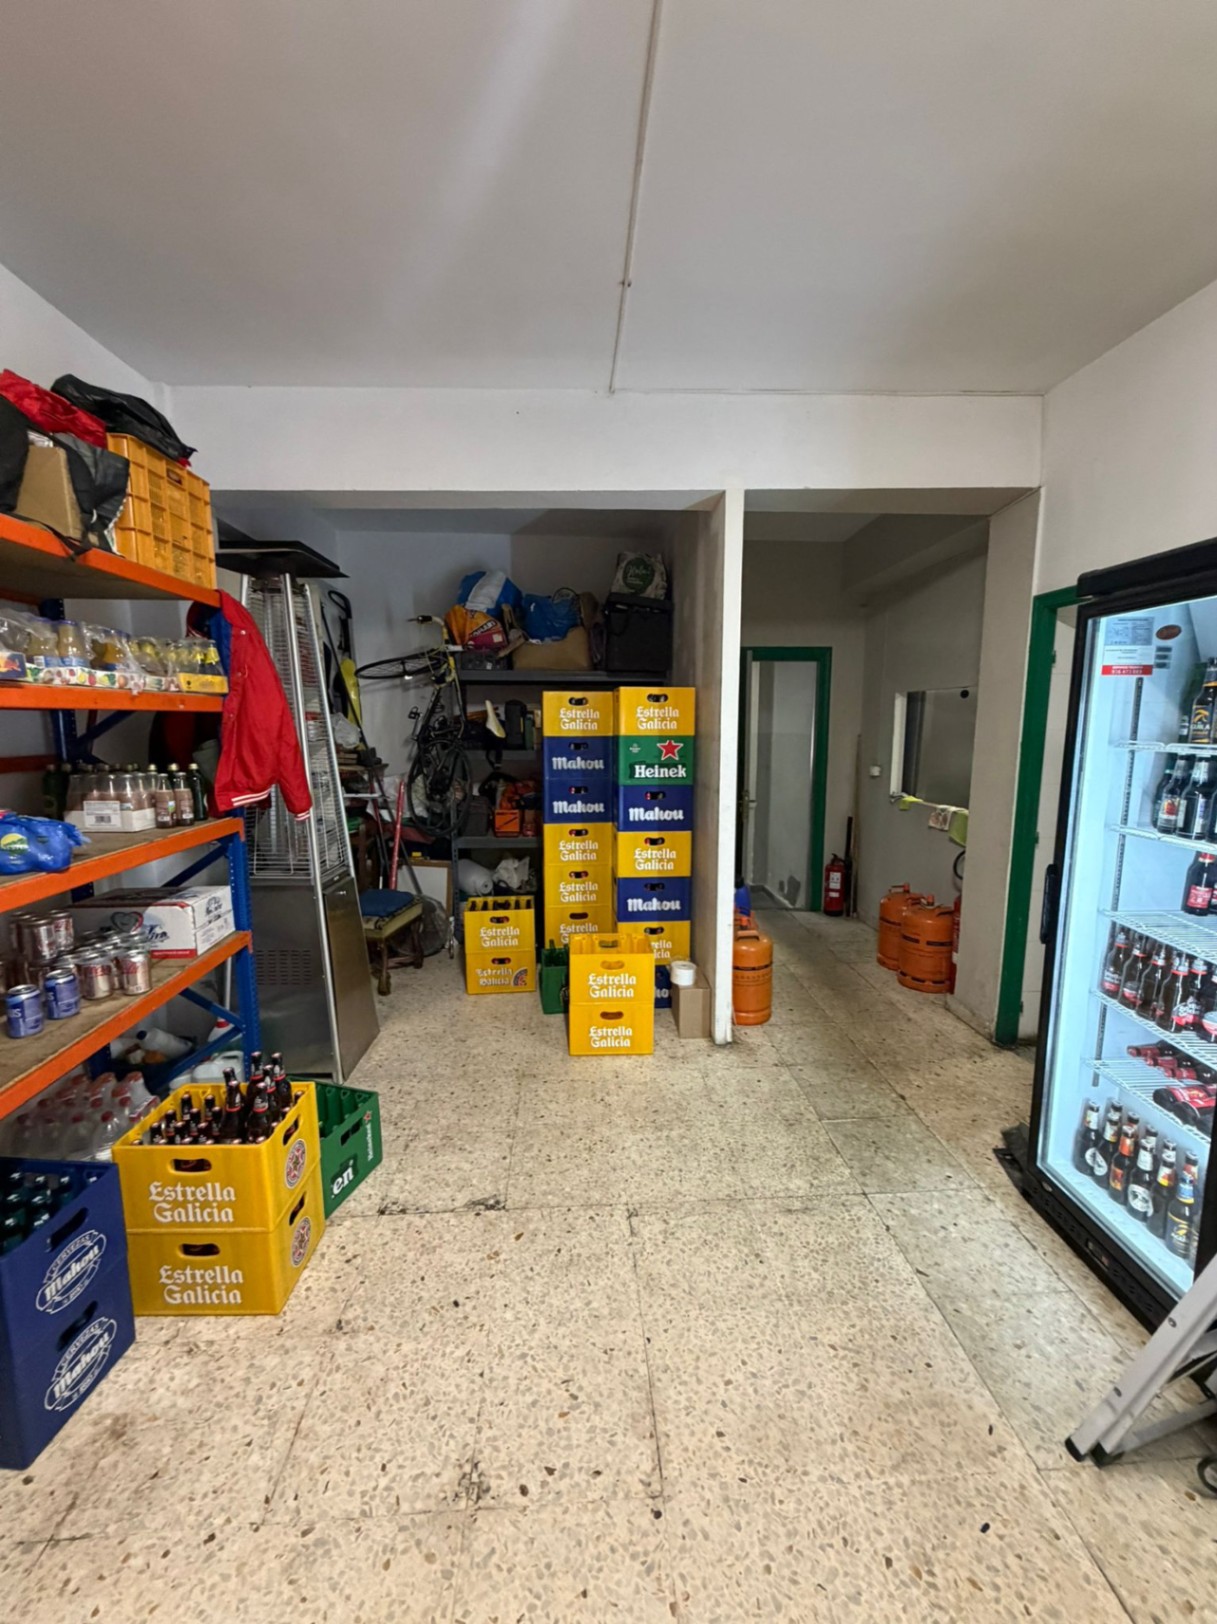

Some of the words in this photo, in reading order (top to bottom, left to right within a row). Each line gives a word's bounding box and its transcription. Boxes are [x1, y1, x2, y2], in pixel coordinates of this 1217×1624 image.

[559, 707, 600, 719] Estrella
[636, 706, 680, 718] Estrella
[560, 718, 598, 731] Galicia
[637, 718, 678, 730] Galicia
[552, 756, 605, 770] Mahou
[634, 764, 687, 778] Heinek
[553, 801, 605, 814] Mahou
[628, 807, 684, 822] Mahou
[559, 840, 598, 850] Estrella
[560, 849, 597, 861] Galicia
[634, 848, 677, 860] Estrella
[635, 859, 675, 871] Galicia
[559, 881, 598, 893] Estrella
[560, 892, 597, 903] Galicia
[627, 897, 681, 912] Mahou
[480, 926, 520, 937] Estrella
[559, 923, 598, 934] Estrella
[481, 936, 519, 948] Galicia
[650, 940, 673, 950] rella
[588, 973, 637, 986] Estrella
[589, 985, 635, 999] Galicia
[589, 1026, 633, 1037] Estrella
[590, 1037, 632, 1048] Galicia
[149, 1181, 237, 1202] Estrella
[153, 1202, 235, 1223] Galicia
[44, 1245, 99, 1301] Mahou
[159, 1265, 244, 1284] Estrella
[163, 1285, 242, 1305] Galicia
[53, 1332, 110, 1399] Mahou
